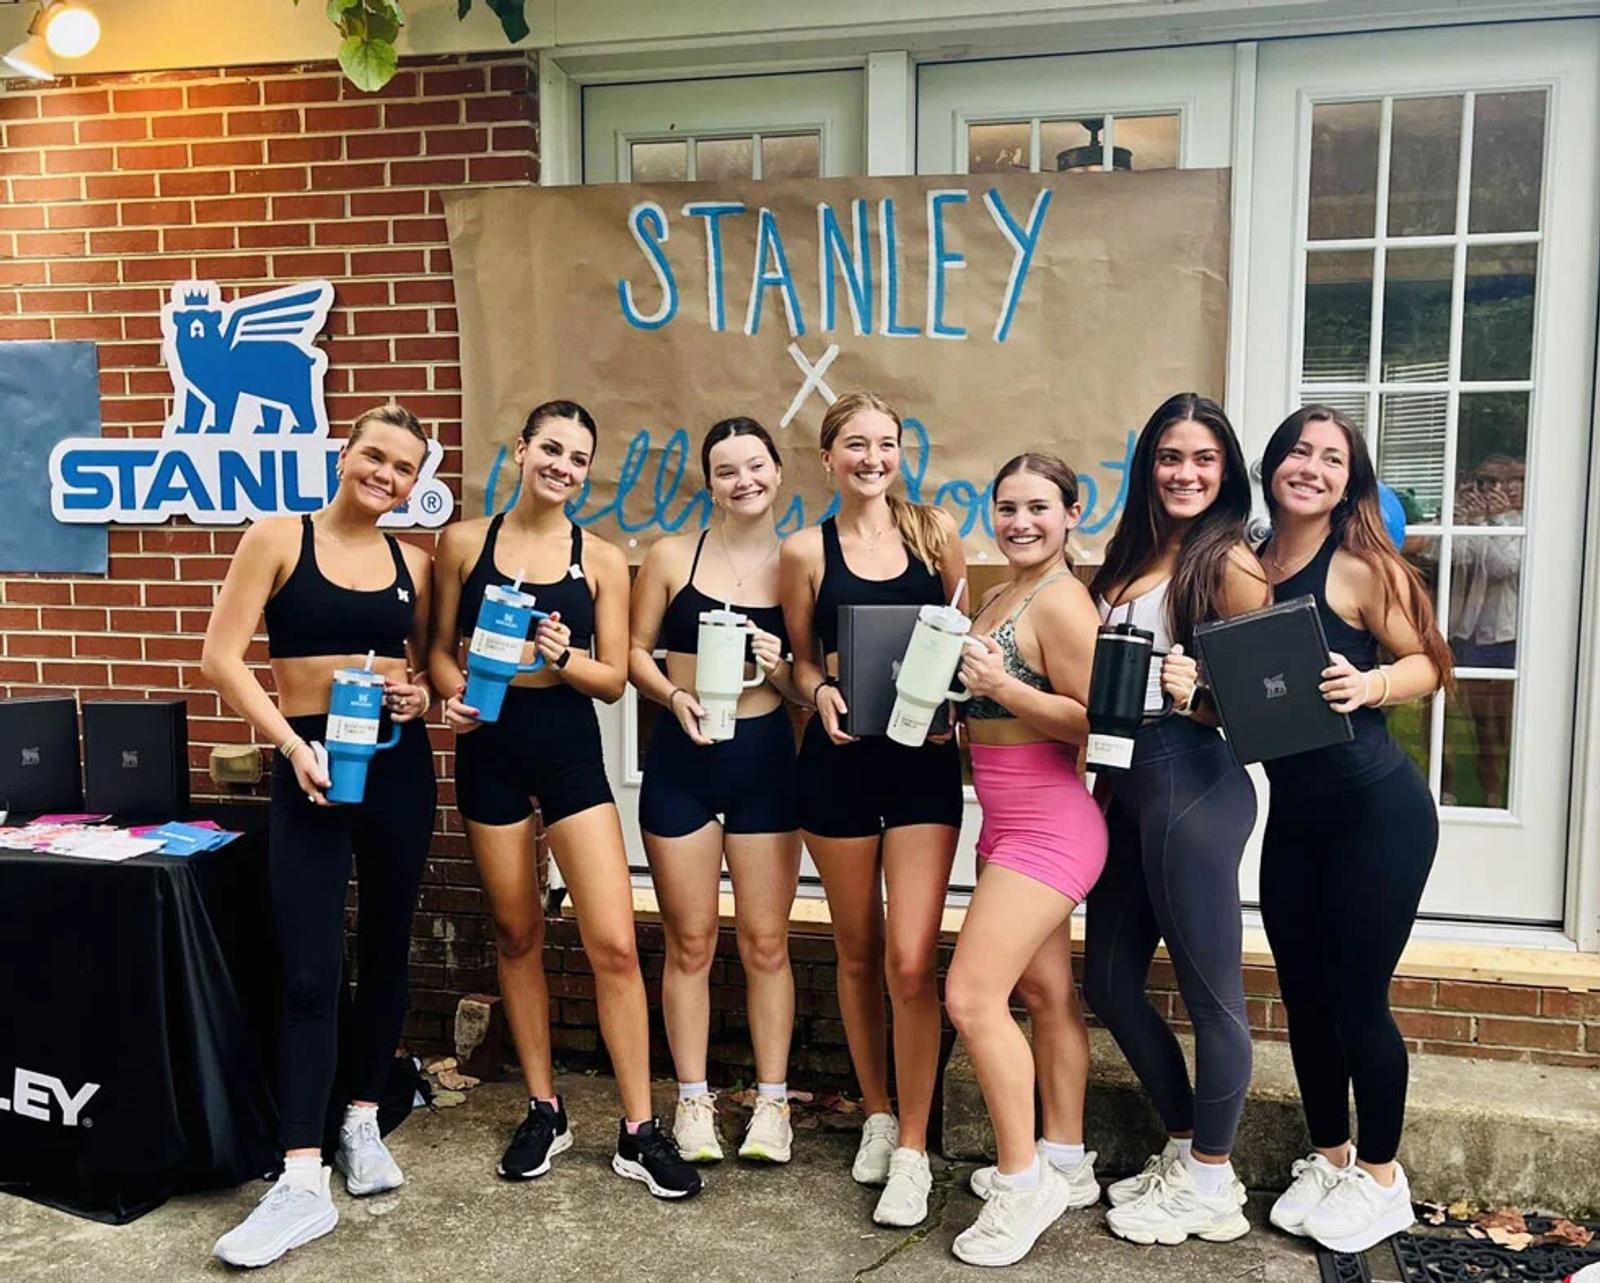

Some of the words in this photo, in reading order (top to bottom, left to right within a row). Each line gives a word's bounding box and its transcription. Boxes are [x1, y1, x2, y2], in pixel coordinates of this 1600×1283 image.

[617, 187, 1053, 342] STANLEY
[60, 449, 411, 514] STANL
[0, 1066, 101, 1126] EY
